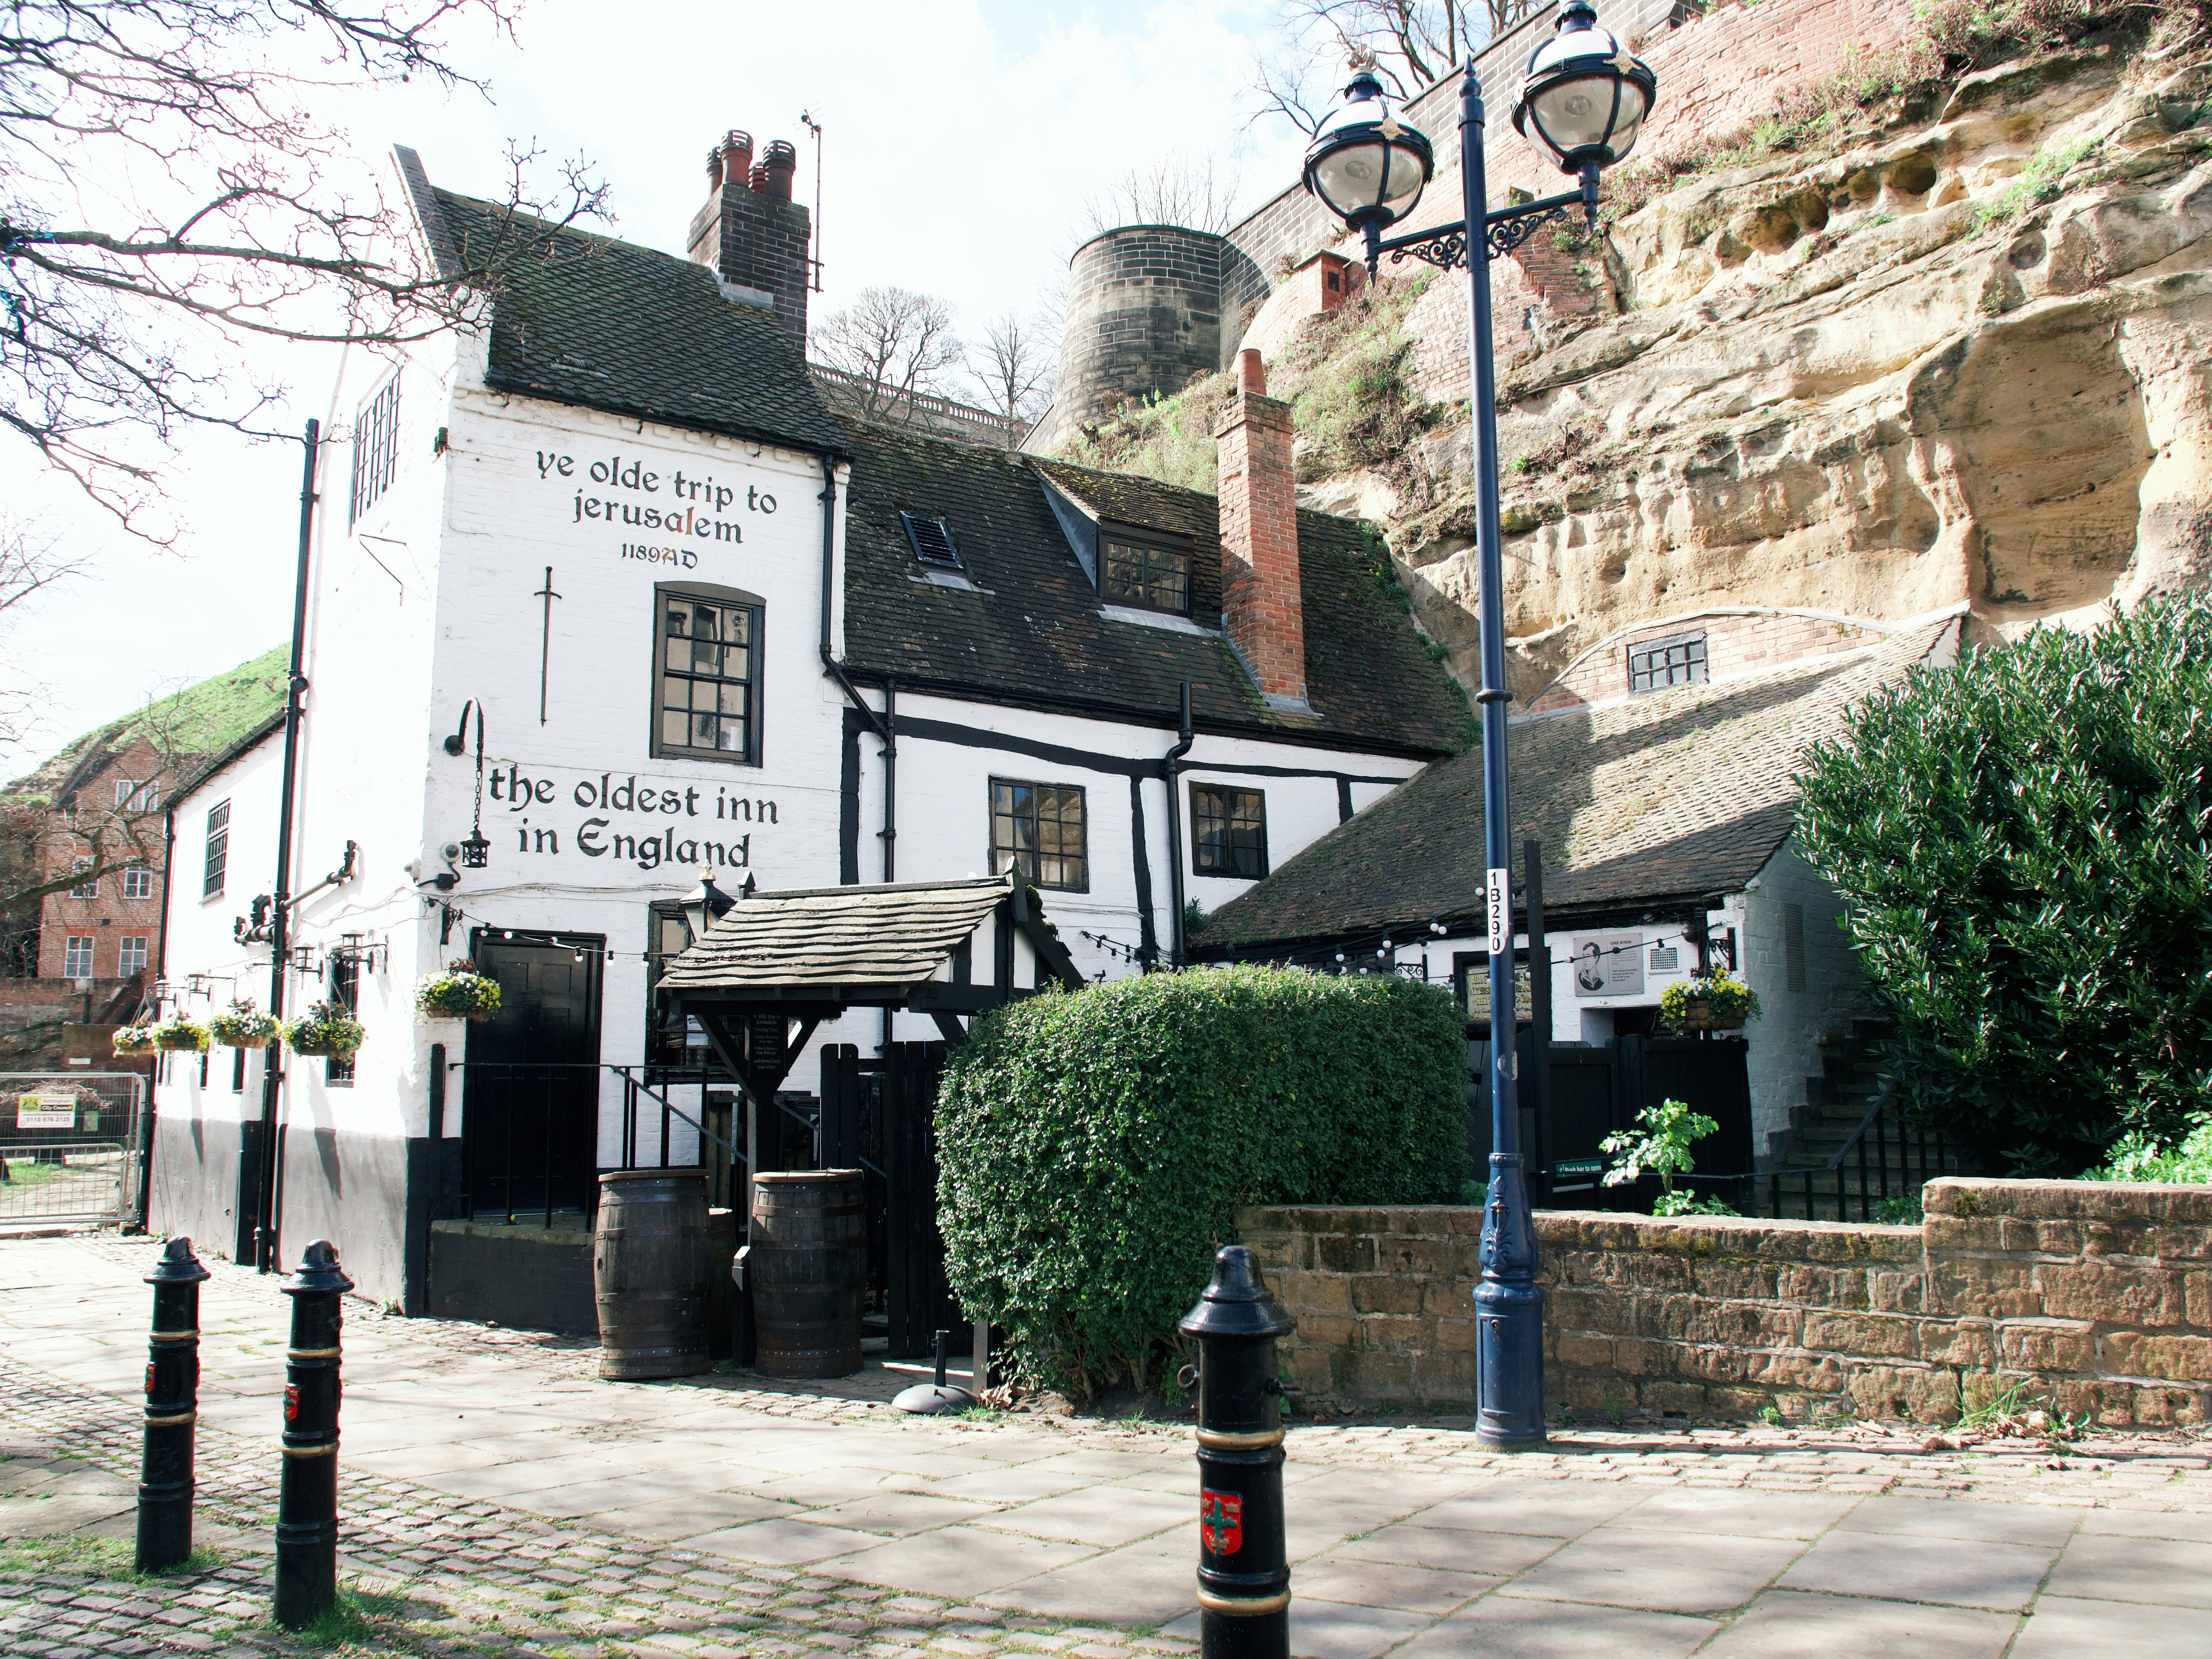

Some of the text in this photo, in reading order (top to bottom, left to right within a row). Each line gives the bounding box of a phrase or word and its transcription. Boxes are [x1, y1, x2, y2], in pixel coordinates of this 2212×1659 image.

[536, 451, 777, 514] ye olde trip to
[573, 489, 743, 544] jerusalem
[489, 763, 779, 824] the oldest inn
[518, 817, 751, 870] in England
[1472, 975, 1482, 984] ADA
